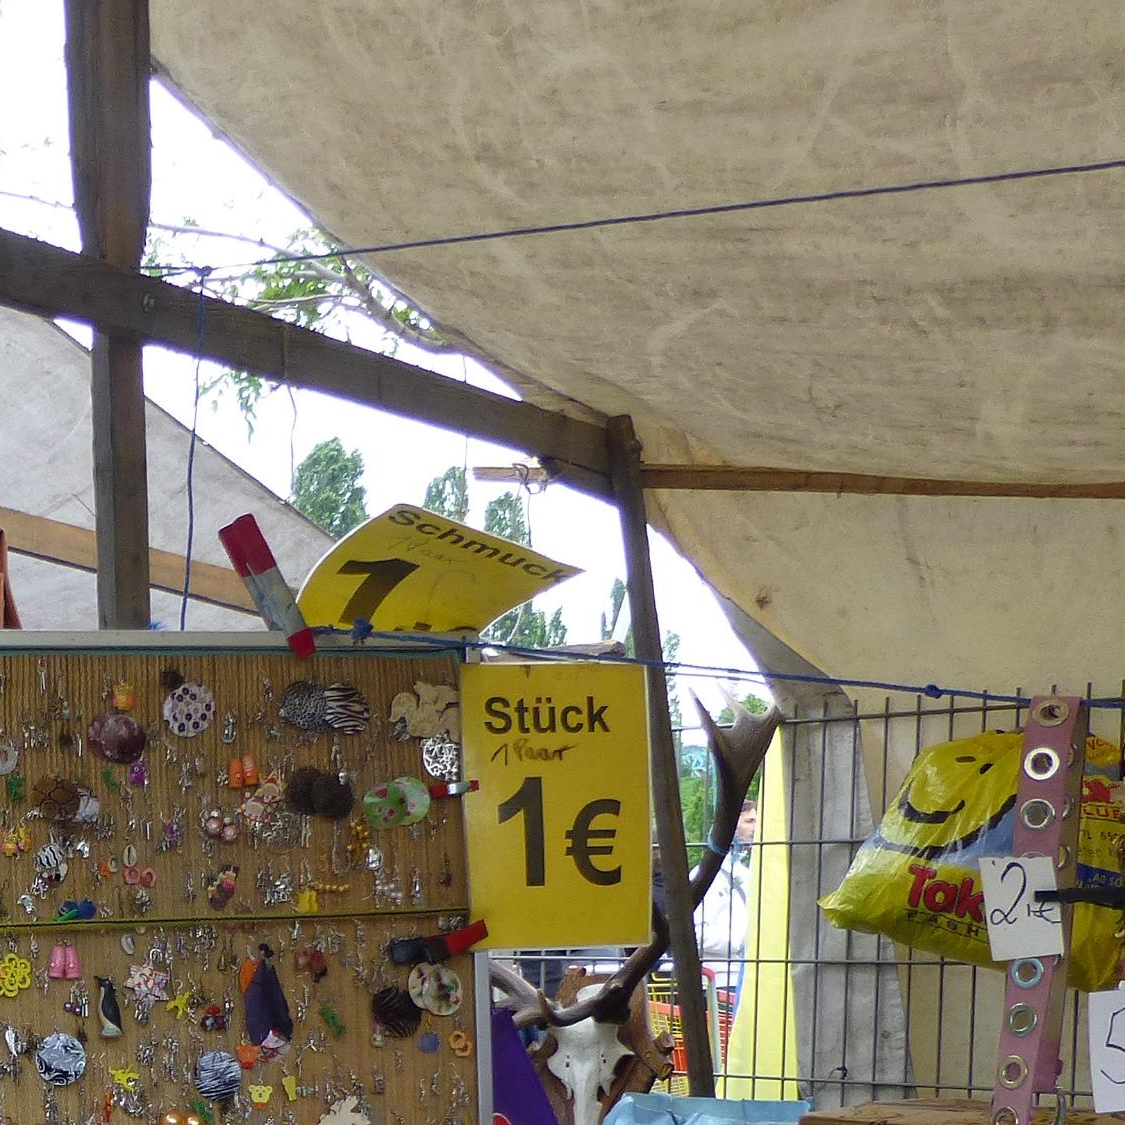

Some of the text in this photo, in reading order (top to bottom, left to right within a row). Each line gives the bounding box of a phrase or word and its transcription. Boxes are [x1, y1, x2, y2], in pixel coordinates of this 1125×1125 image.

[388, 509, 565, 583] Schmuck
[483, 695, 612, 735] Stück
[491, 743, 508, 767] 1
[908, 863, 985, 923] Tak
